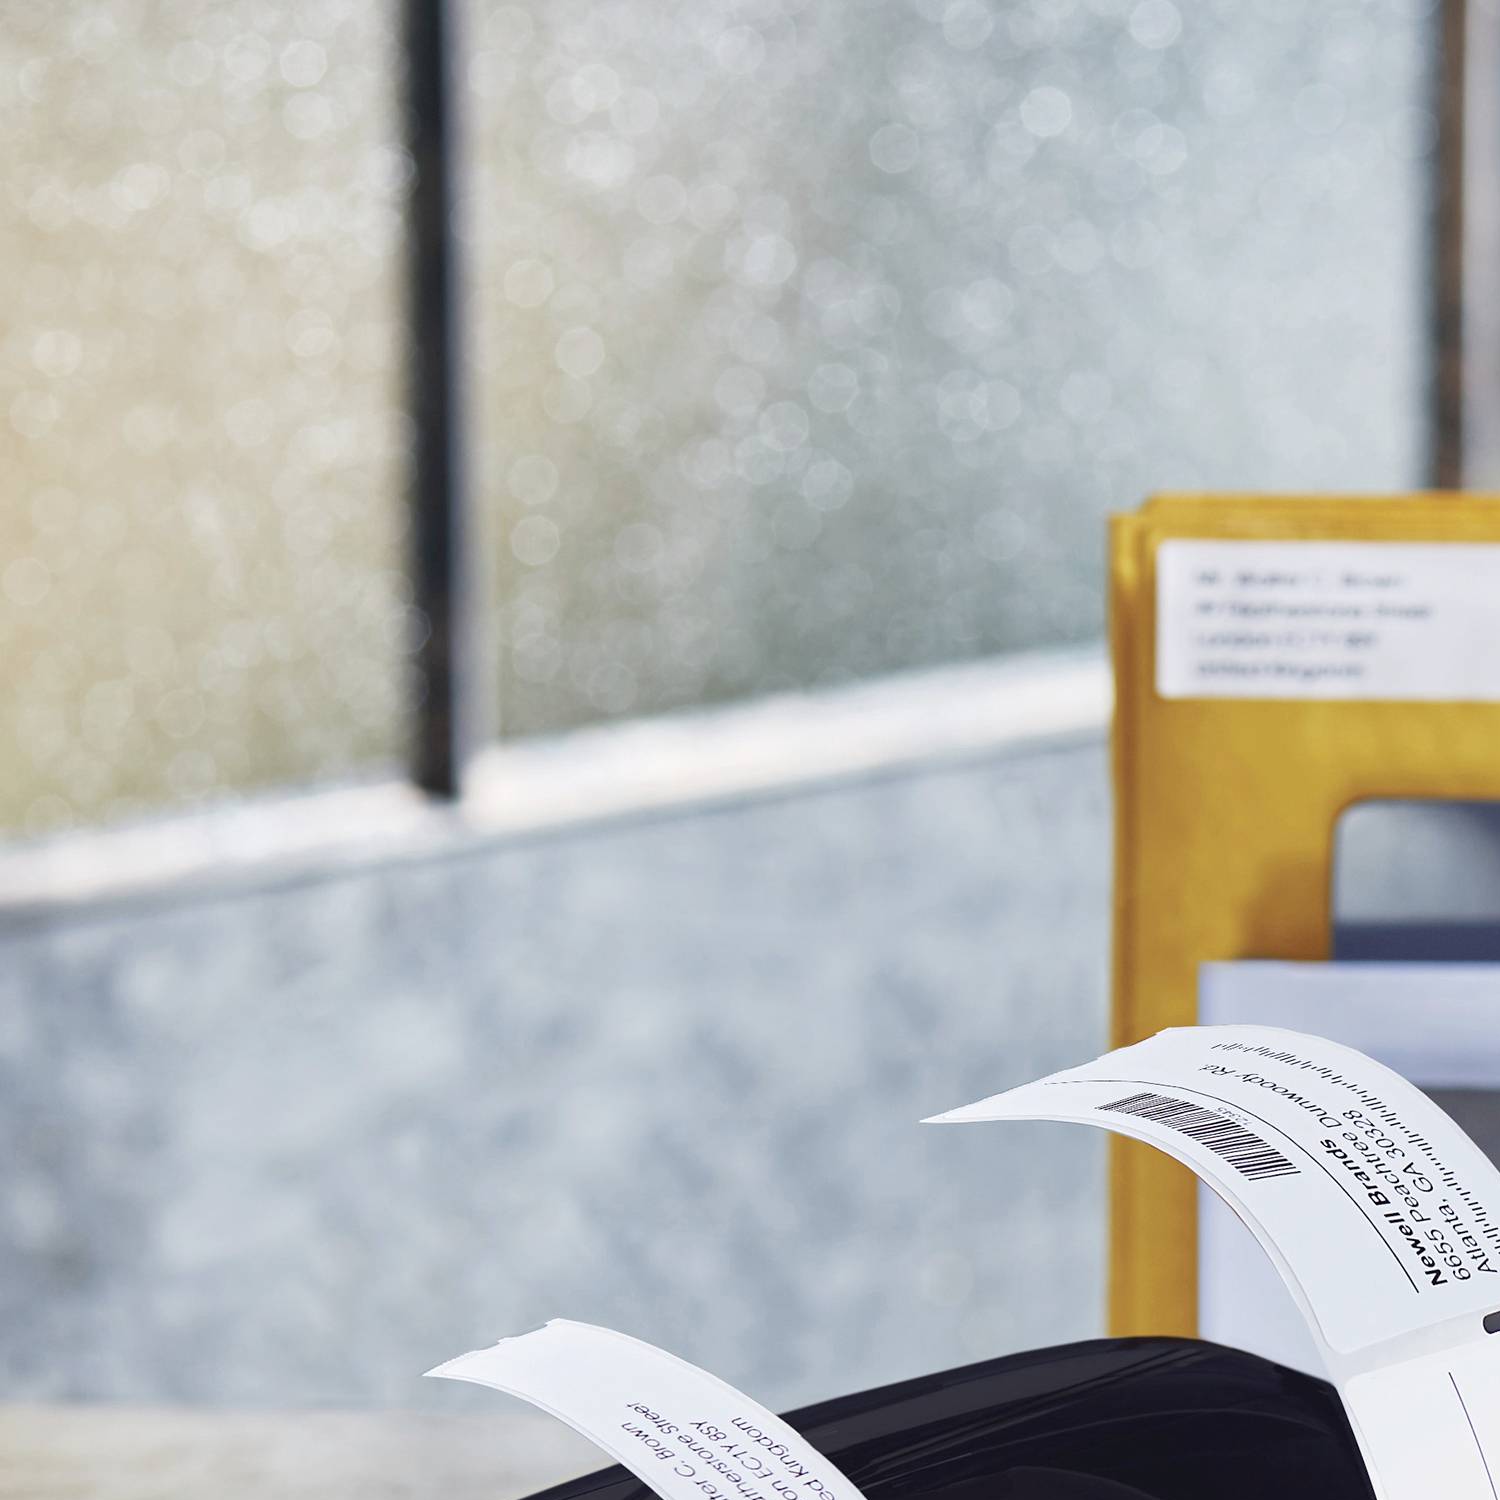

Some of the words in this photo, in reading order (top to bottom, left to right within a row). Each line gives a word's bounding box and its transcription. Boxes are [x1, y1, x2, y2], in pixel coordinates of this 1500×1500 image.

[1236, 1073, 1342, 1129] Dunwoody
[1342, 1108, 1406, 1160] 30328
[1319, 1137, 1391, 1207] Brands
[1341, 1131, 1432, 1223] Peachtree
[1402, 1161, 1434, 1194] GA
[1384, 1211, 1449, 1286] Newell
[1424, 1228, 1472, 1281] 6655
[1439, 1198, 1498, 1274] Atlanta,
[621, 1421, 675, 1461] Brown
[626, 1401, 679, 1435] Street
[689, 1419, 728, 1442] 8SY
[674, 1460, 696, 1478] C.
[720, 1443, 774, 1480] EC1Y
[730, 1416, 809, 1479] Kingdom
